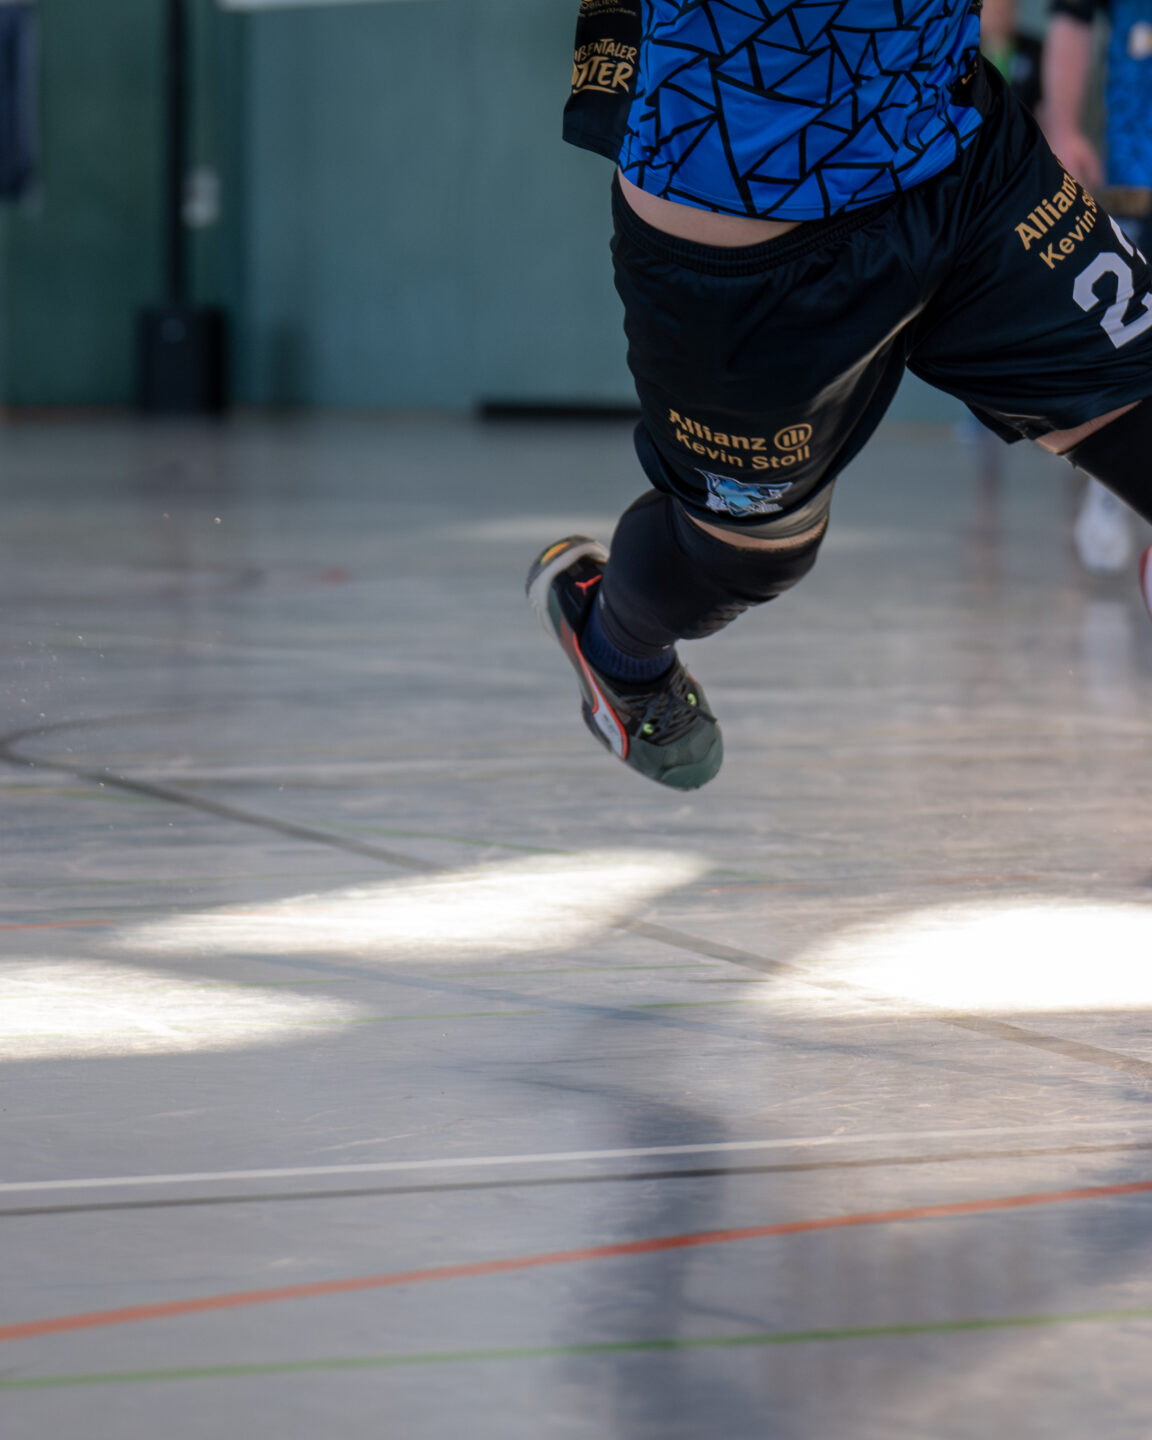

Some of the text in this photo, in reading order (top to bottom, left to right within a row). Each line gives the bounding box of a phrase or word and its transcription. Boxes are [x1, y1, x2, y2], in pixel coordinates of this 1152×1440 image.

[1039, 212, 1098, 269] Kevin
[669, 408, 768, 452] Allianz
[676, 429, 811, 471] Kevin Stoll
